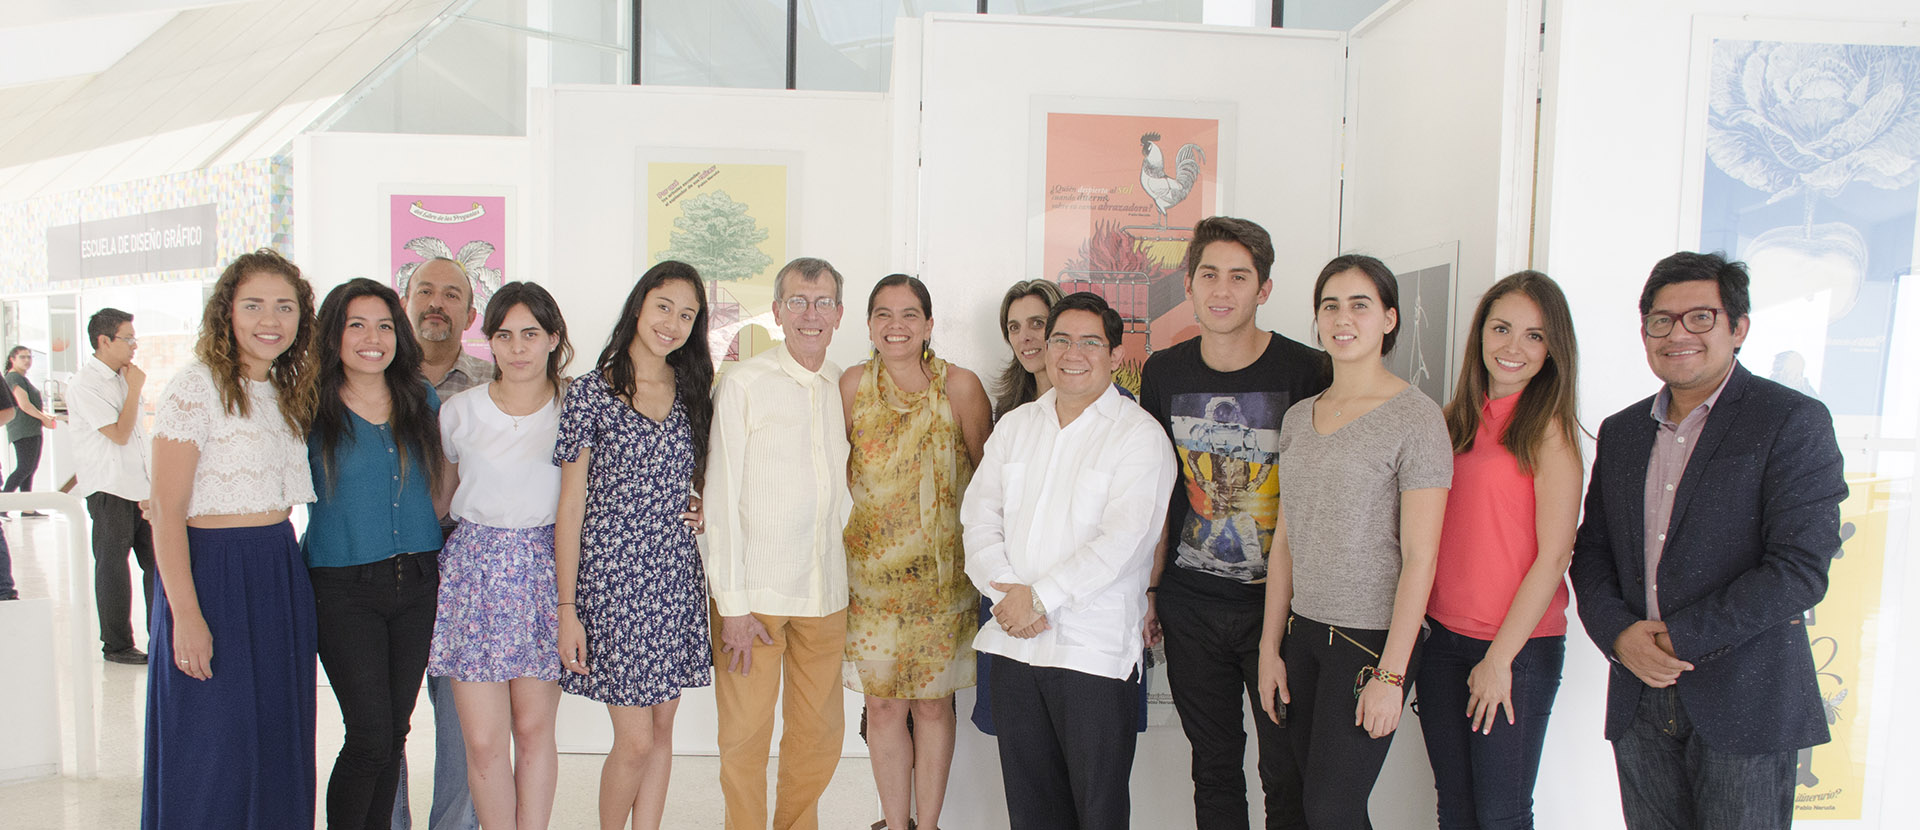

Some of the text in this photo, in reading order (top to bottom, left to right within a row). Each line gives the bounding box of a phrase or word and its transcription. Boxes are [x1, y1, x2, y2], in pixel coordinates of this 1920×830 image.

[1118, 183, 1134, 195] sol
[81, 224, 202, 258] ESCUELA DE DISEÑO GRÁFICO
